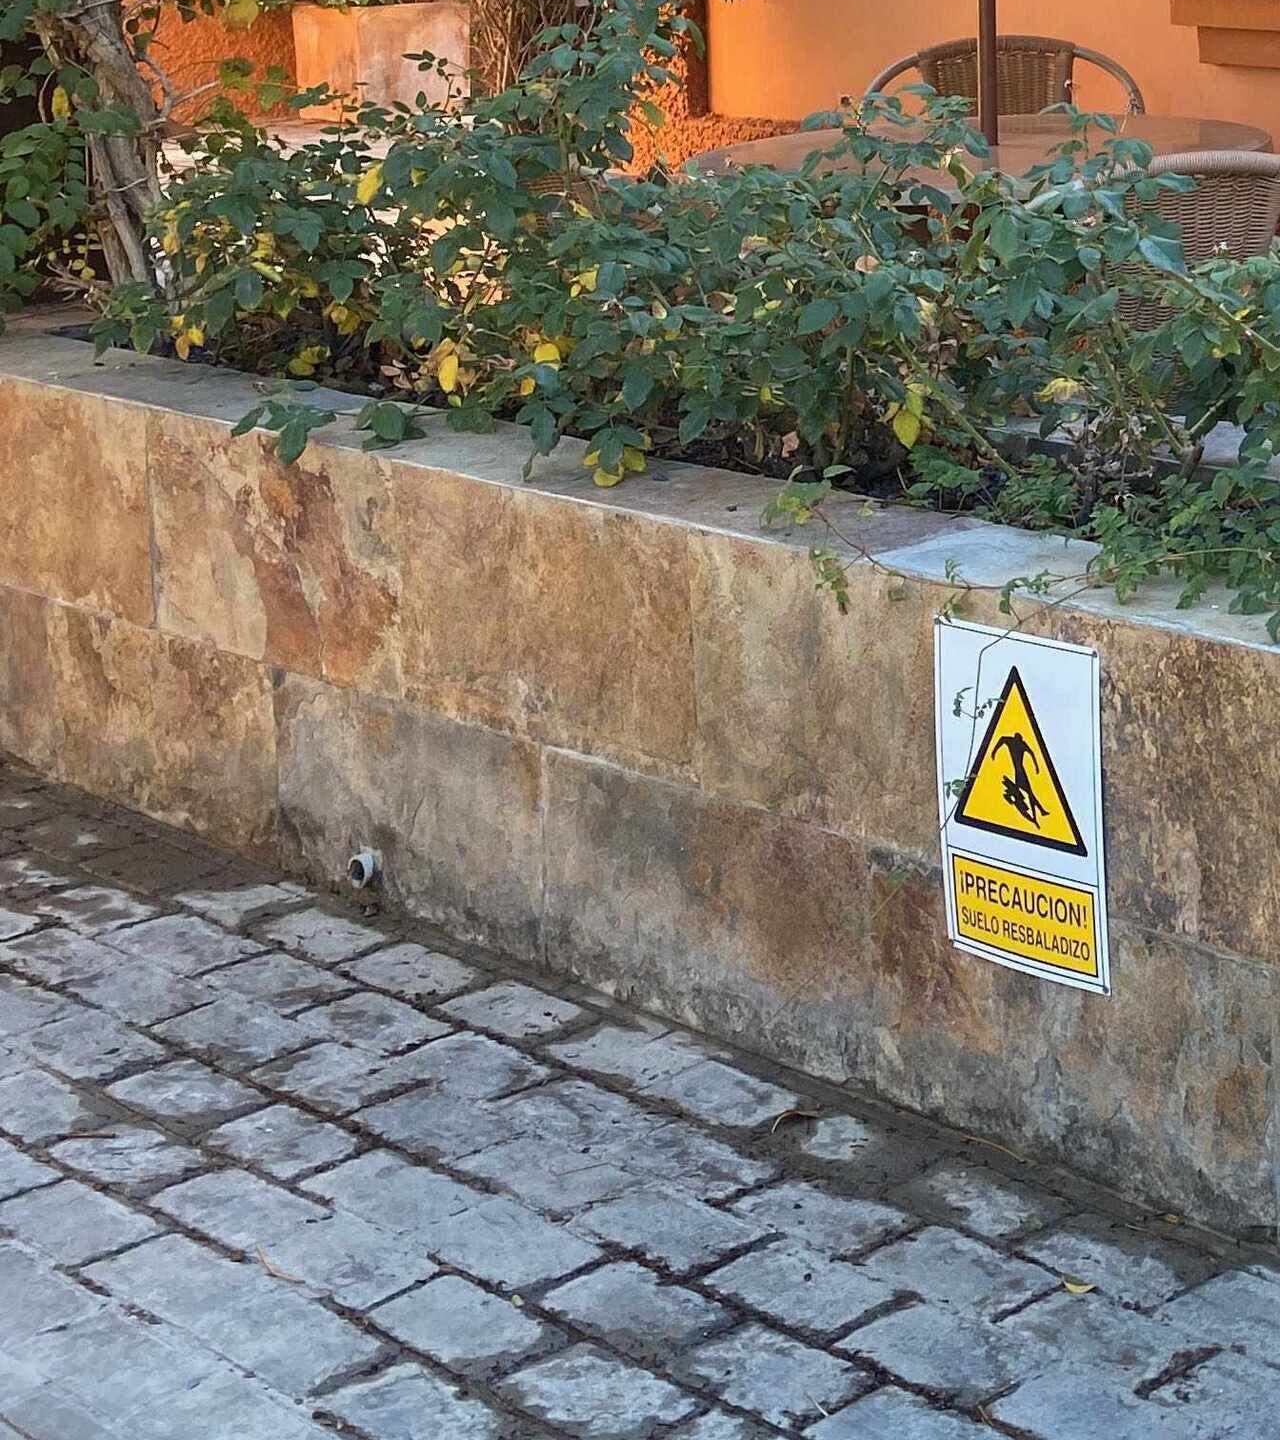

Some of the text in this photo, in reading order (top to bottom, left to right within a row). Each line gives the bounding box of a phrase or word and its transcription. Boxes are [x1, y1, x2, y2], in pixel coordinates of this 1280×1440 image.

[960, 871, 1087, 929] ¡PRECAUCION!
[961, 906, 1090, 961] SUELO RESBALADIZO
